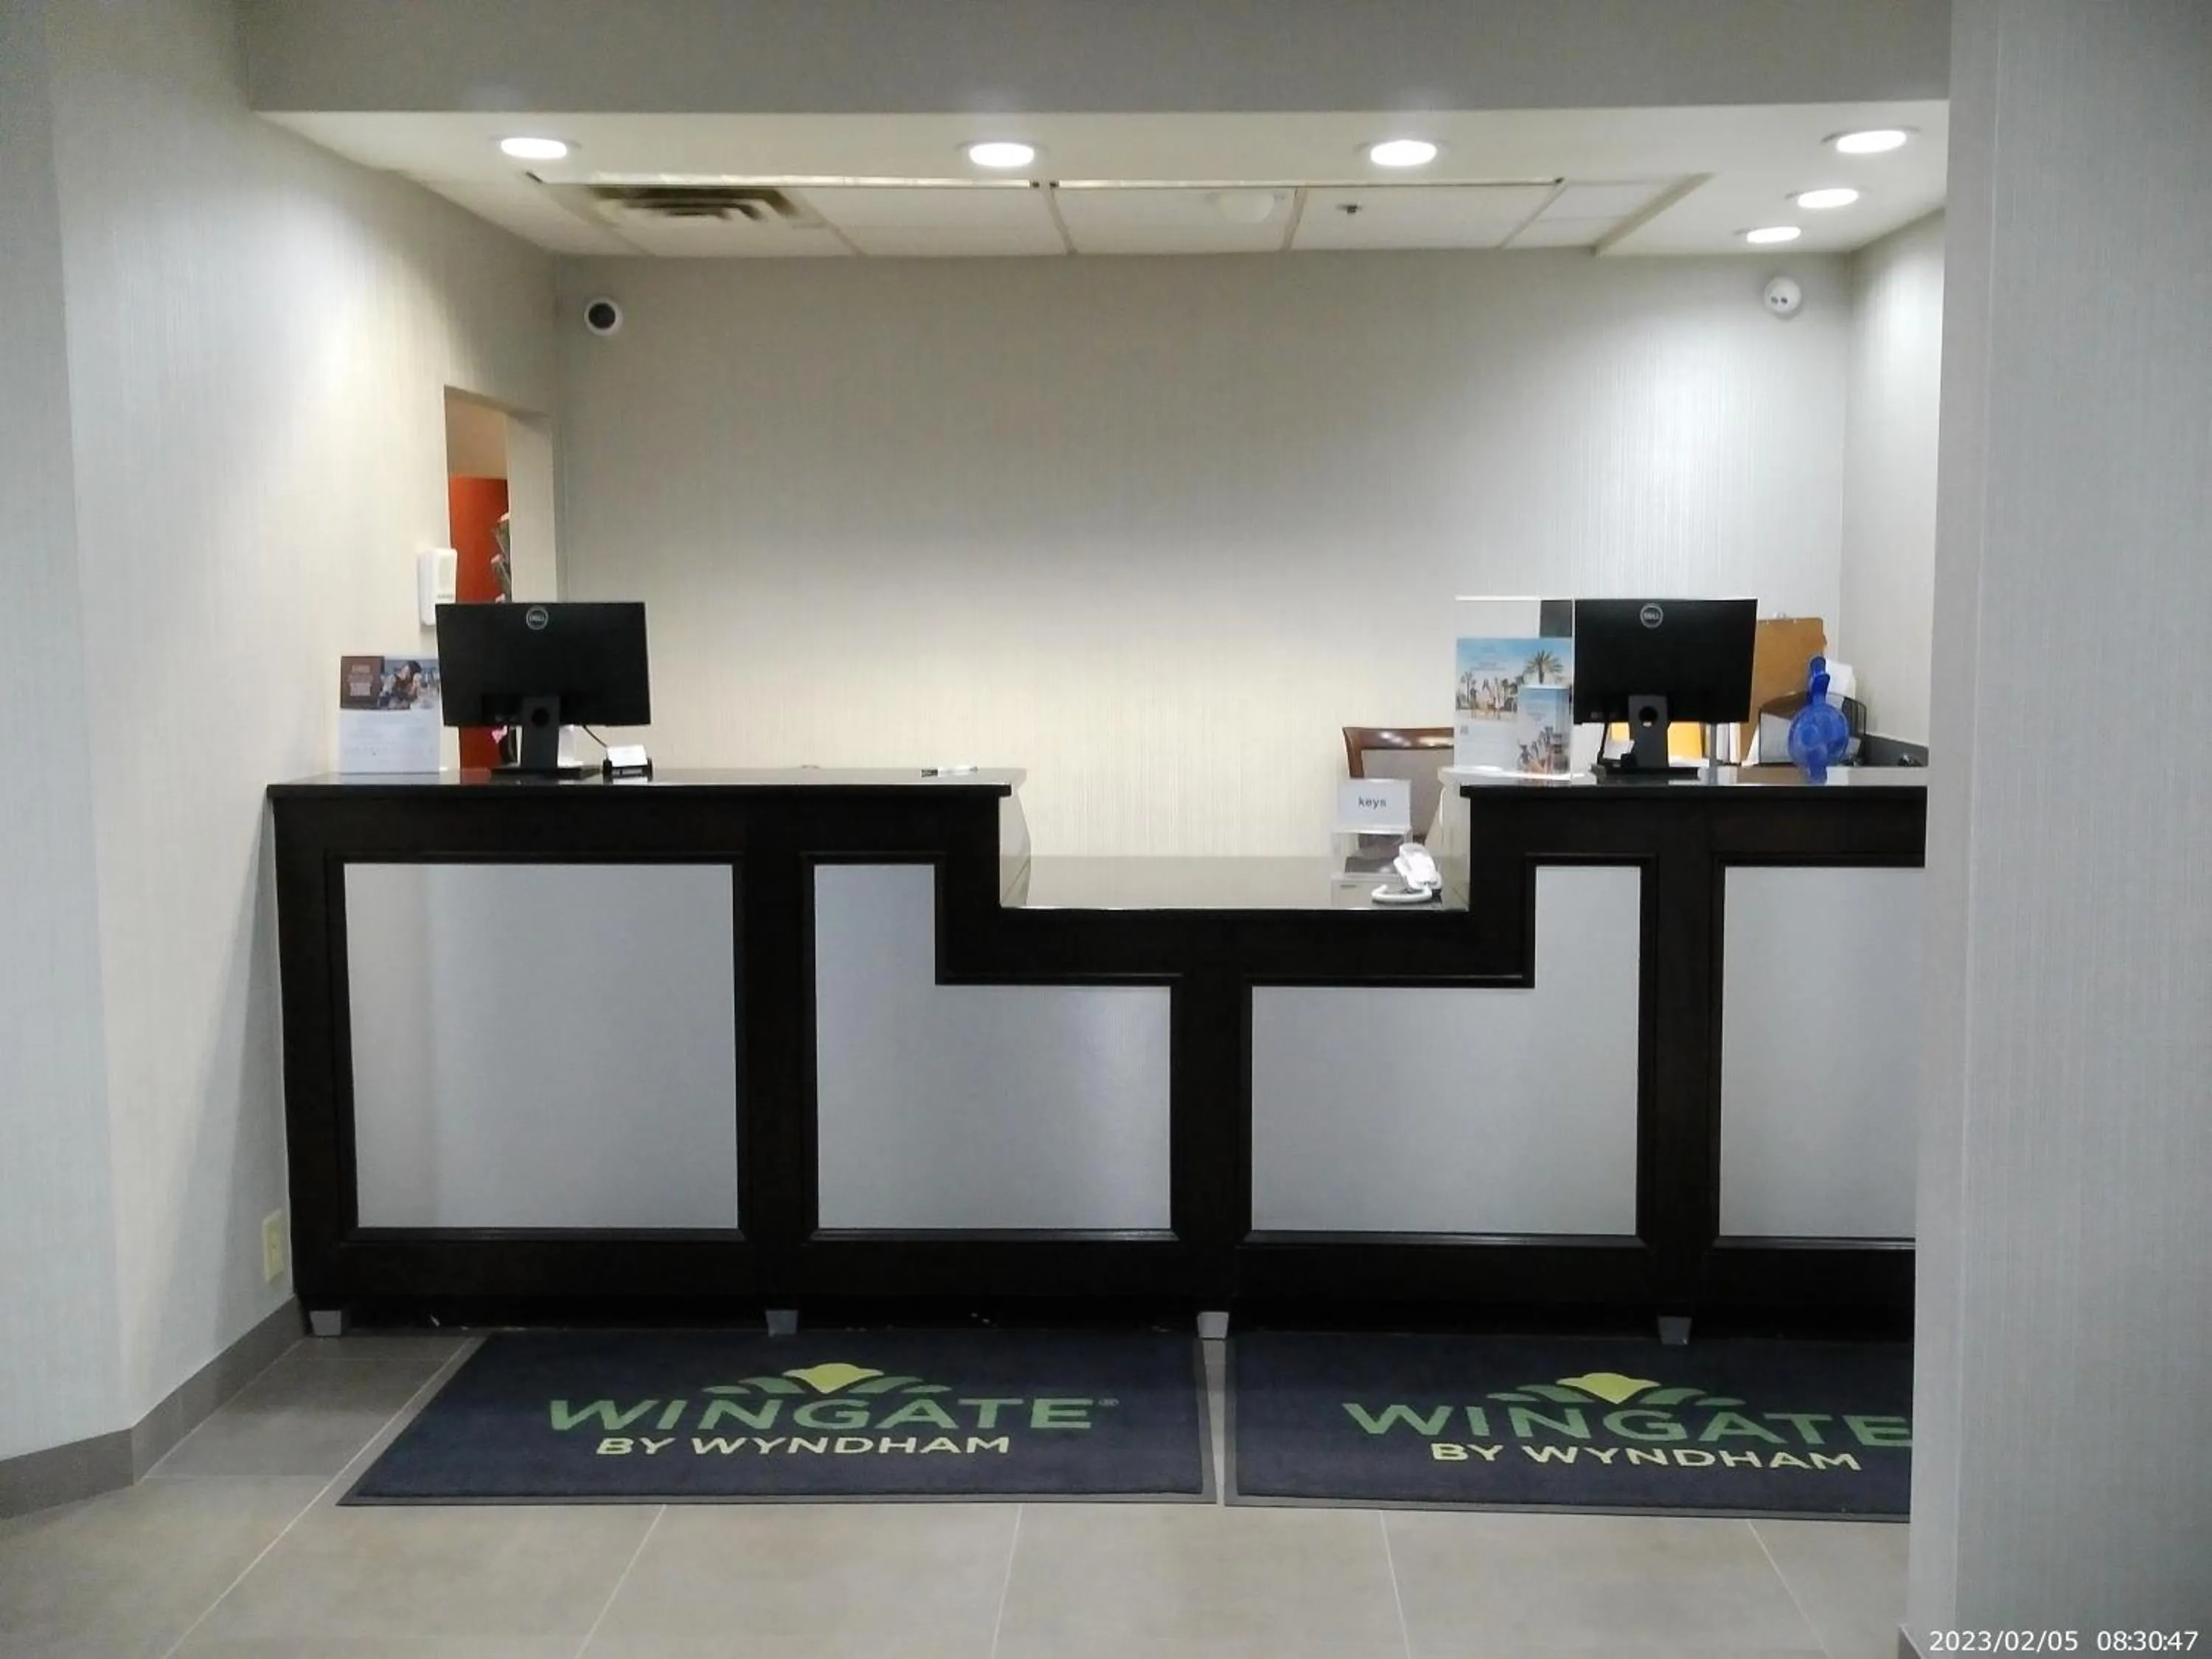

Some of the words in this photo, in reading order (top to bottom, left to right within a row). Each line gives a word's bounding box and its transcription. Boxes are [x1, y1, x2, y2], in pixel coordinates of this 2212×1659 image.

[549, 1398, 1093, 1430] WINGATE
[1342, 1402, 1912, 1447] WINGATE
[596, 1436, 675, 1455] BY
[690, 1436, 1009, 1455] WYNDHAM
[1431, 1442, 1504, 1462] BY
[1522, 1445, 1863, 1471] WYNDHAM
